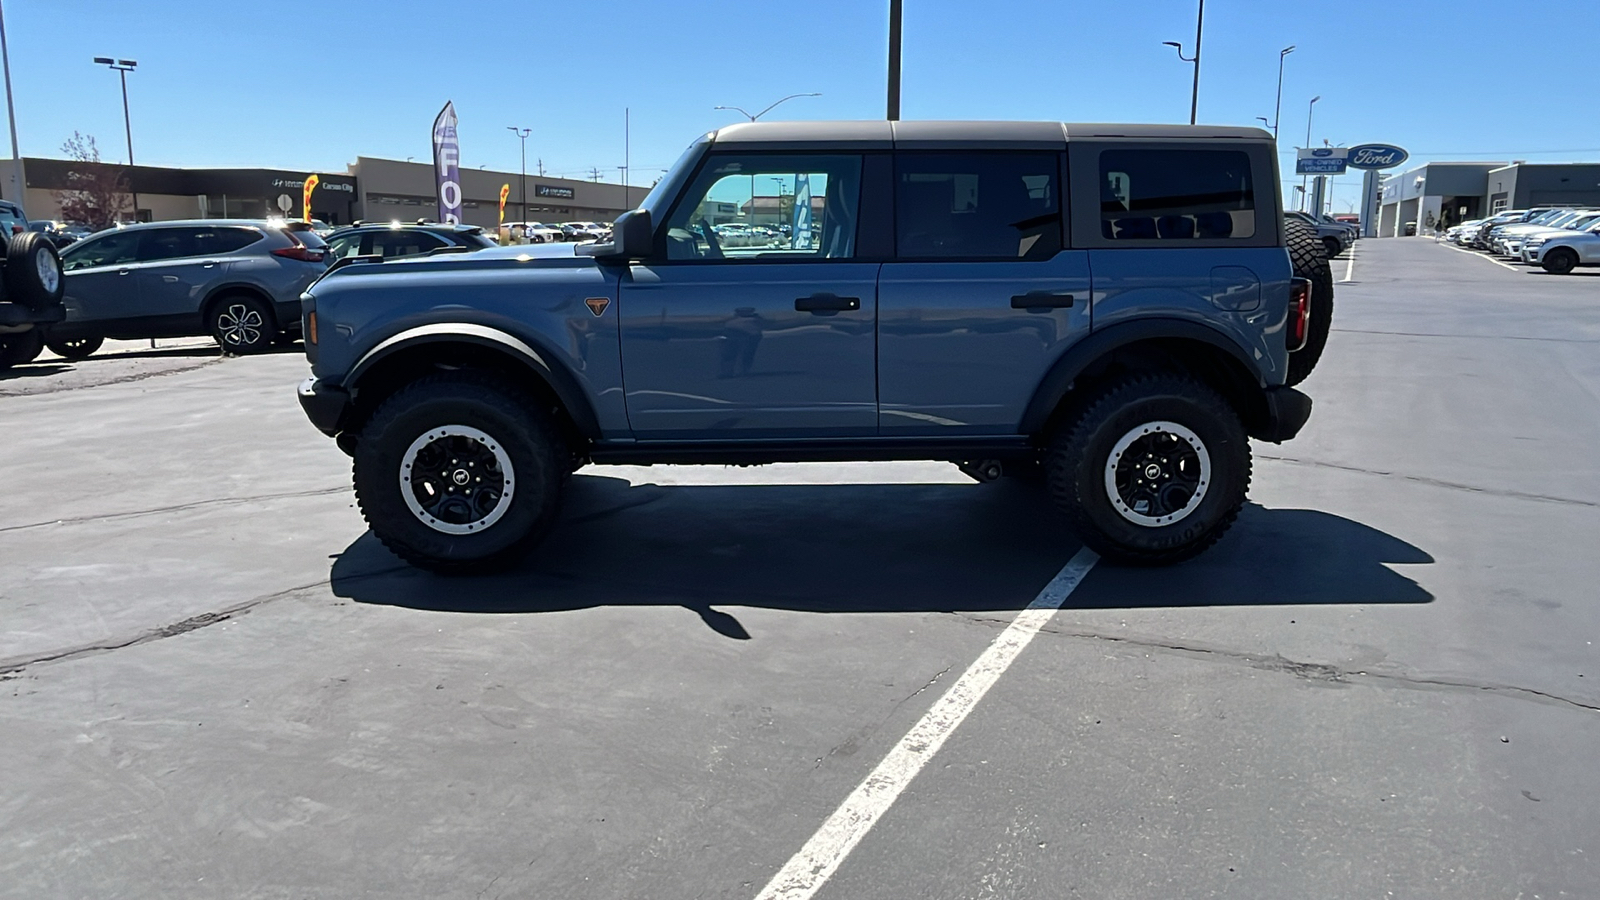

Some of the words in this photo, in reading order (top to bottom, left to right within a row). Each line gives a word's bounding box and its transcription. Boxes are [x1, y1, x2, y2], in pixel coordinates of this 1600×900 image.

[1353, 149, 1395, 164] Ford
[322, 182, 341, 190] Carson
[342, 183, 354, 193] City
